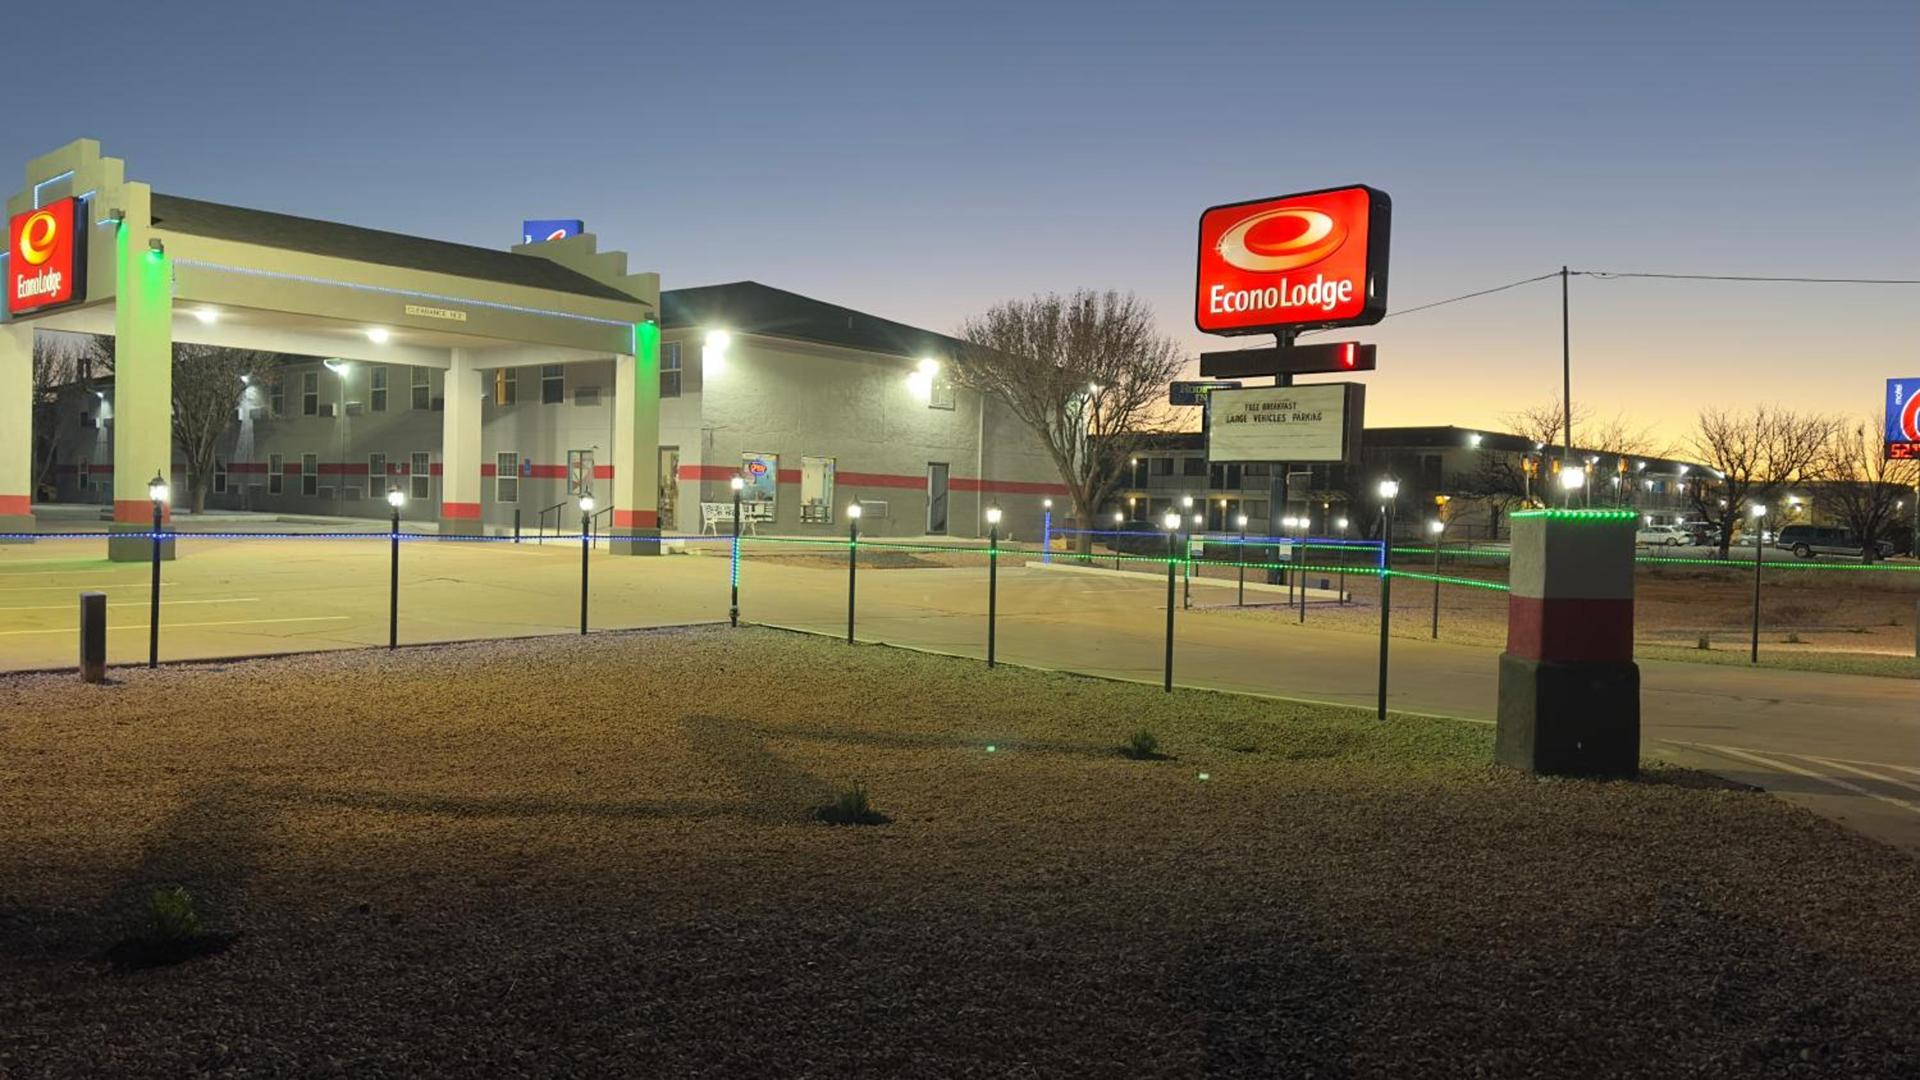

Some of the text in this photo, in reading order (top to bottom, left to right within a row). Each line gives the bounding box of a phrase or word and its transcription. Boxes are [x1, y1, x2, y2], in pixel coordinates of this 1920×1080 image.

[1210, 274, 1352, 314] EconoLodge
[1262, 402, 1297, 411] BREAKFAST
[1226, 411, 1322, 423] LARGE VEHICLES PARKING
